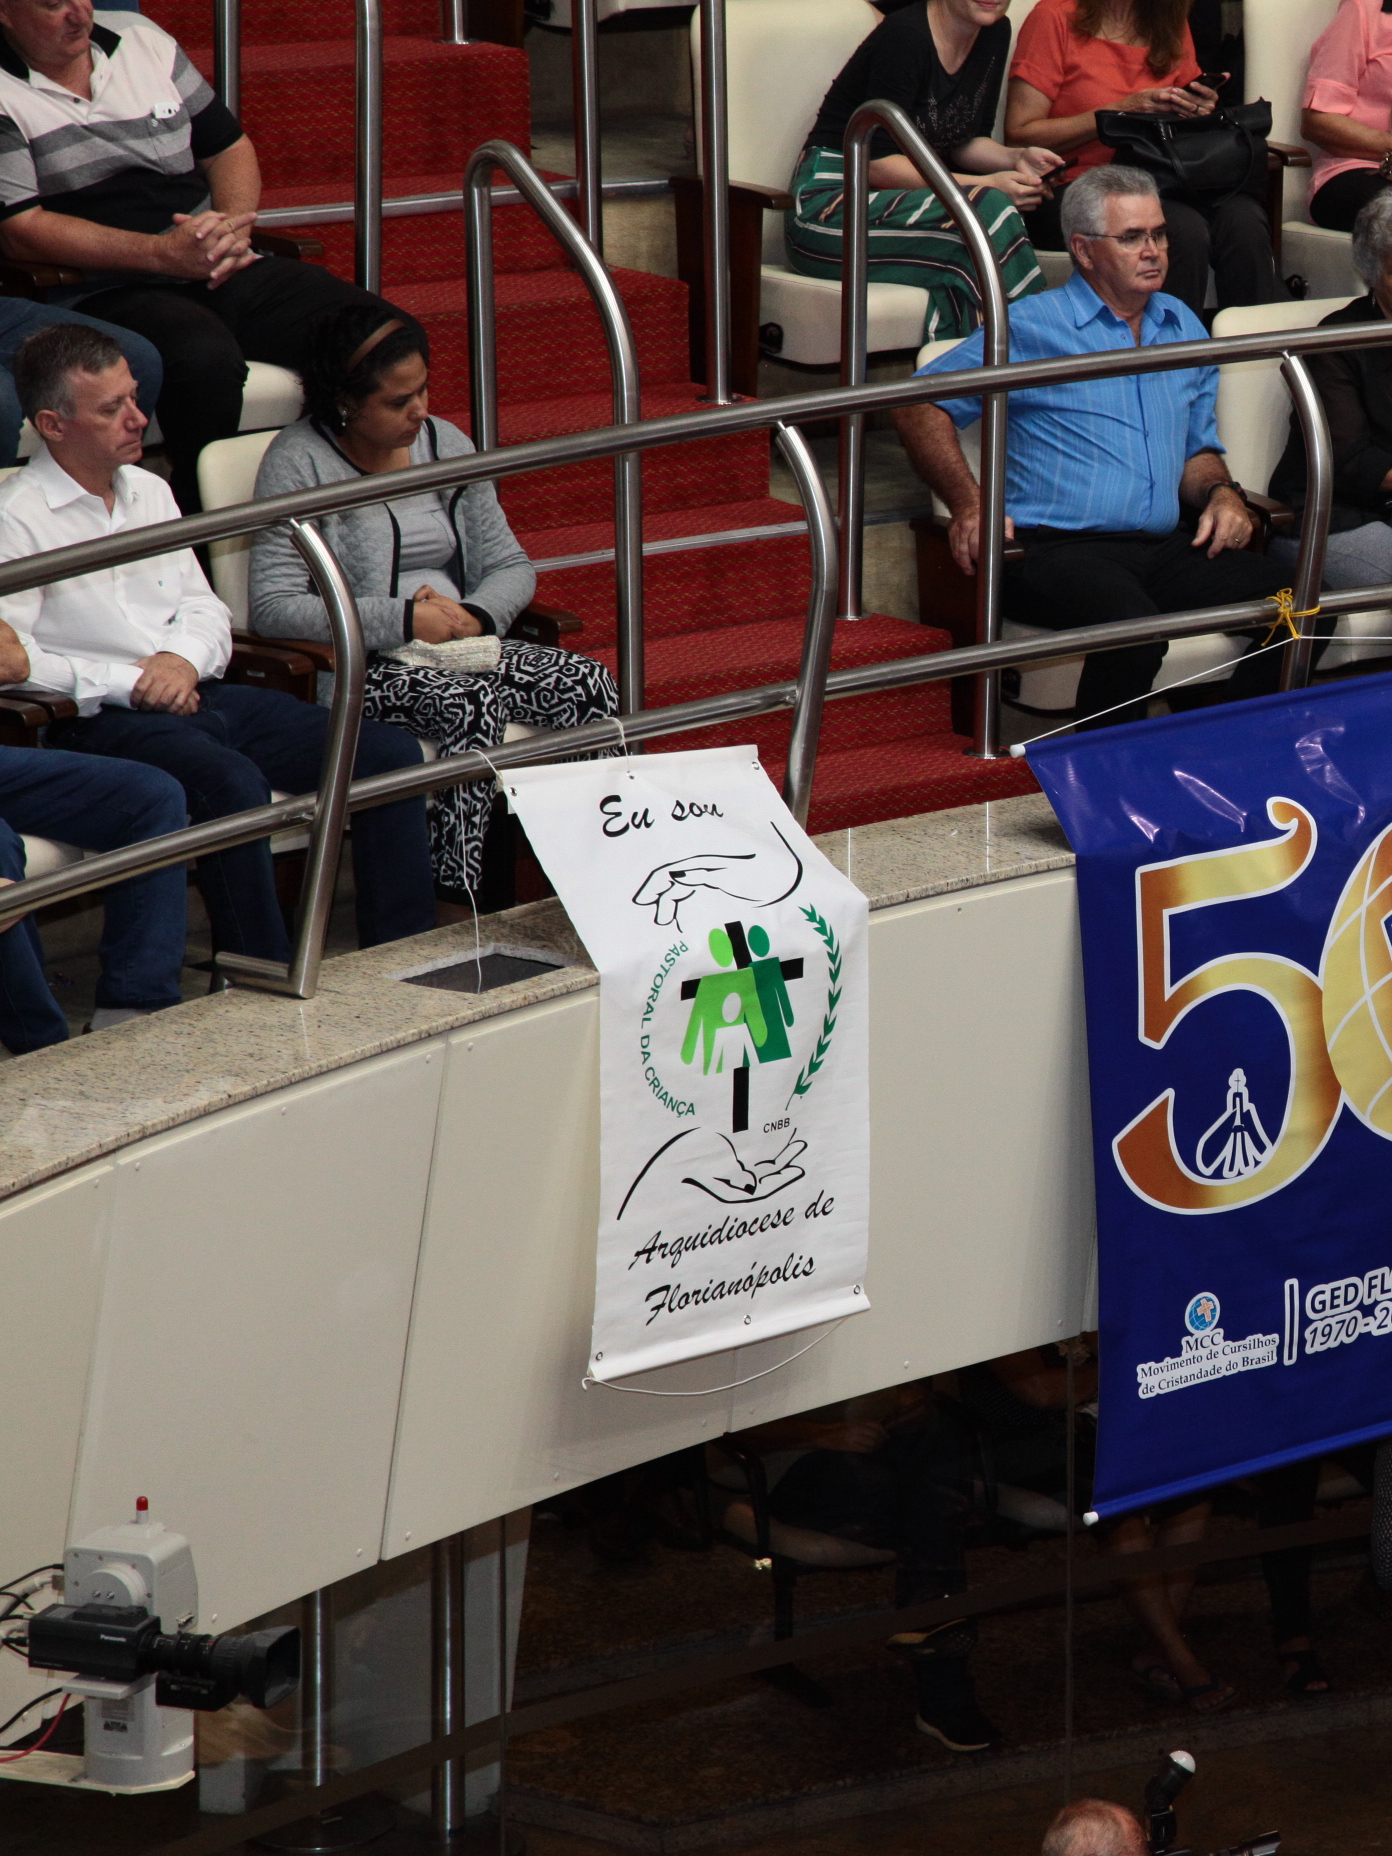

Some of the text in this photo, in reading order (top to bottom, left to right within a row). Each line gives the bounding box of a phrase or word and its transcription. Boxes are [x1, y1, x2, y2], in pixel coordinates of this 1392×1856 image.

[599, 794, 724, 837] Eu sou
[640, 940, 696, 1118] PASTORAL DA CRIANÇA
[763, 1117, 790, 1134] CNBB
[628, 1189, 835, 1270] Arquidiocese de
[645, 1253, 817, 1326] Florianópolis
[1310, 1282, 1359, 1315] GED
[1140, 1337, 1277, 1379] Movimento de Cursilhos
[1185, 1332, 1221, 1354] MCC
[1141, 1350, 1275, 1395] de Cristandade do Brasil
